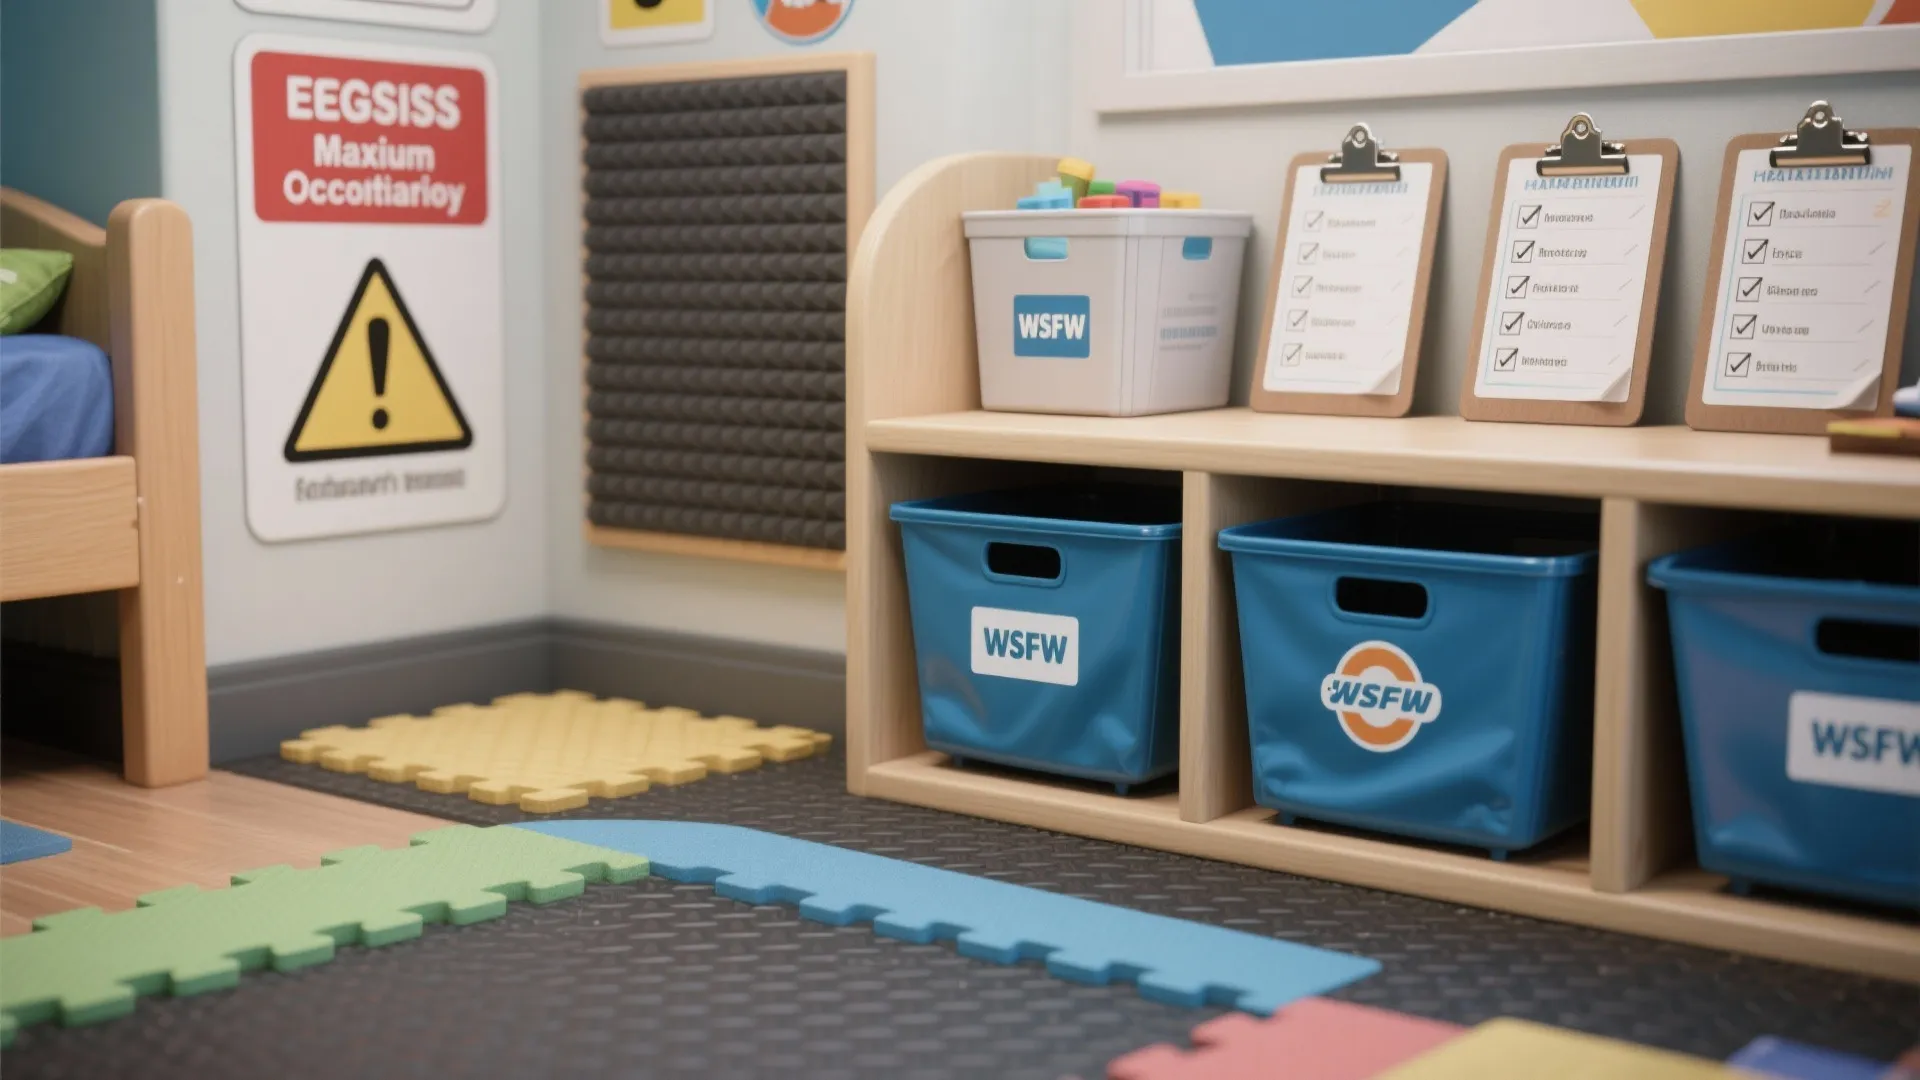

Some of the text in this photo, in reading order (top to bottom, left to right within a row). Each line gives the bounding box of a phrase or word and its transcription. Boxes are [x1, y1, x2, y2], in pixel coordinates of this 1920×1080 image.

[286, 74, 461, 129] EEGSISS
[313, 133, 435, 171] Maxium
[1018, 313, 1086, 340] WSFW
[983, 627, 1068, 664] WSFW
[1329, 680, 1433, 714] WSFW
